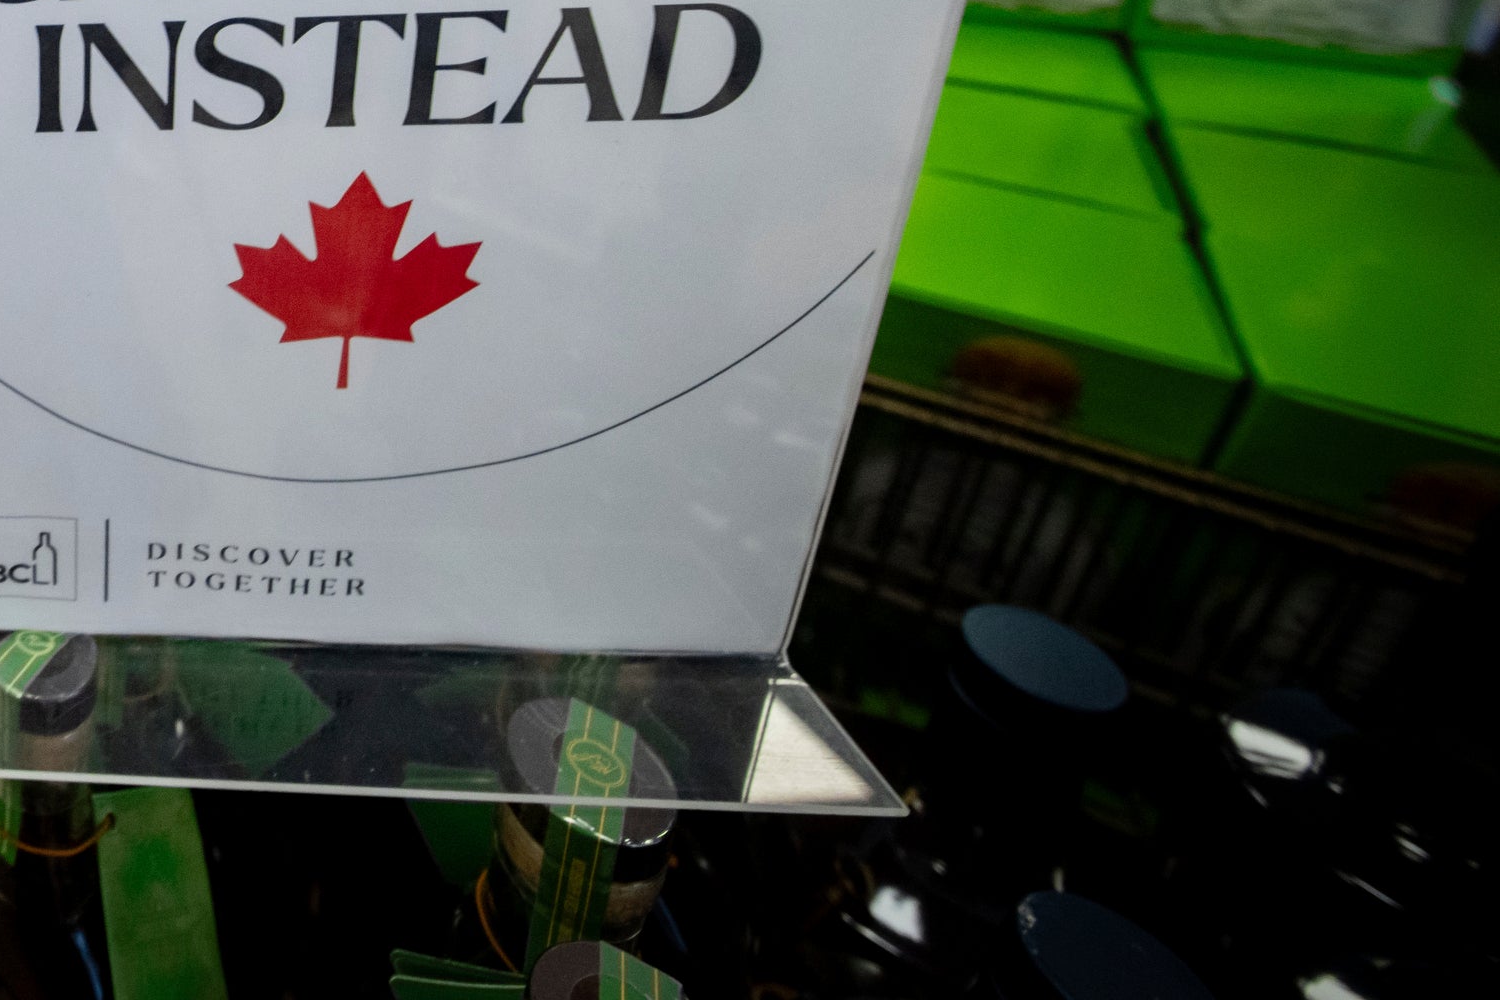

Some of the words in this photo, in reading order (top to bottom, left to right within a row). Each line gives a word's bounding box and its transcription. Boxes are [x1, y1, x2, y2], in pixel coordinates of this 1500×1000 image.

[34, 2, 763, 133] INSTEAD
[147, 542, 355, 568] DISCOVER
[147, 570, 367, 597] TOGETHER
